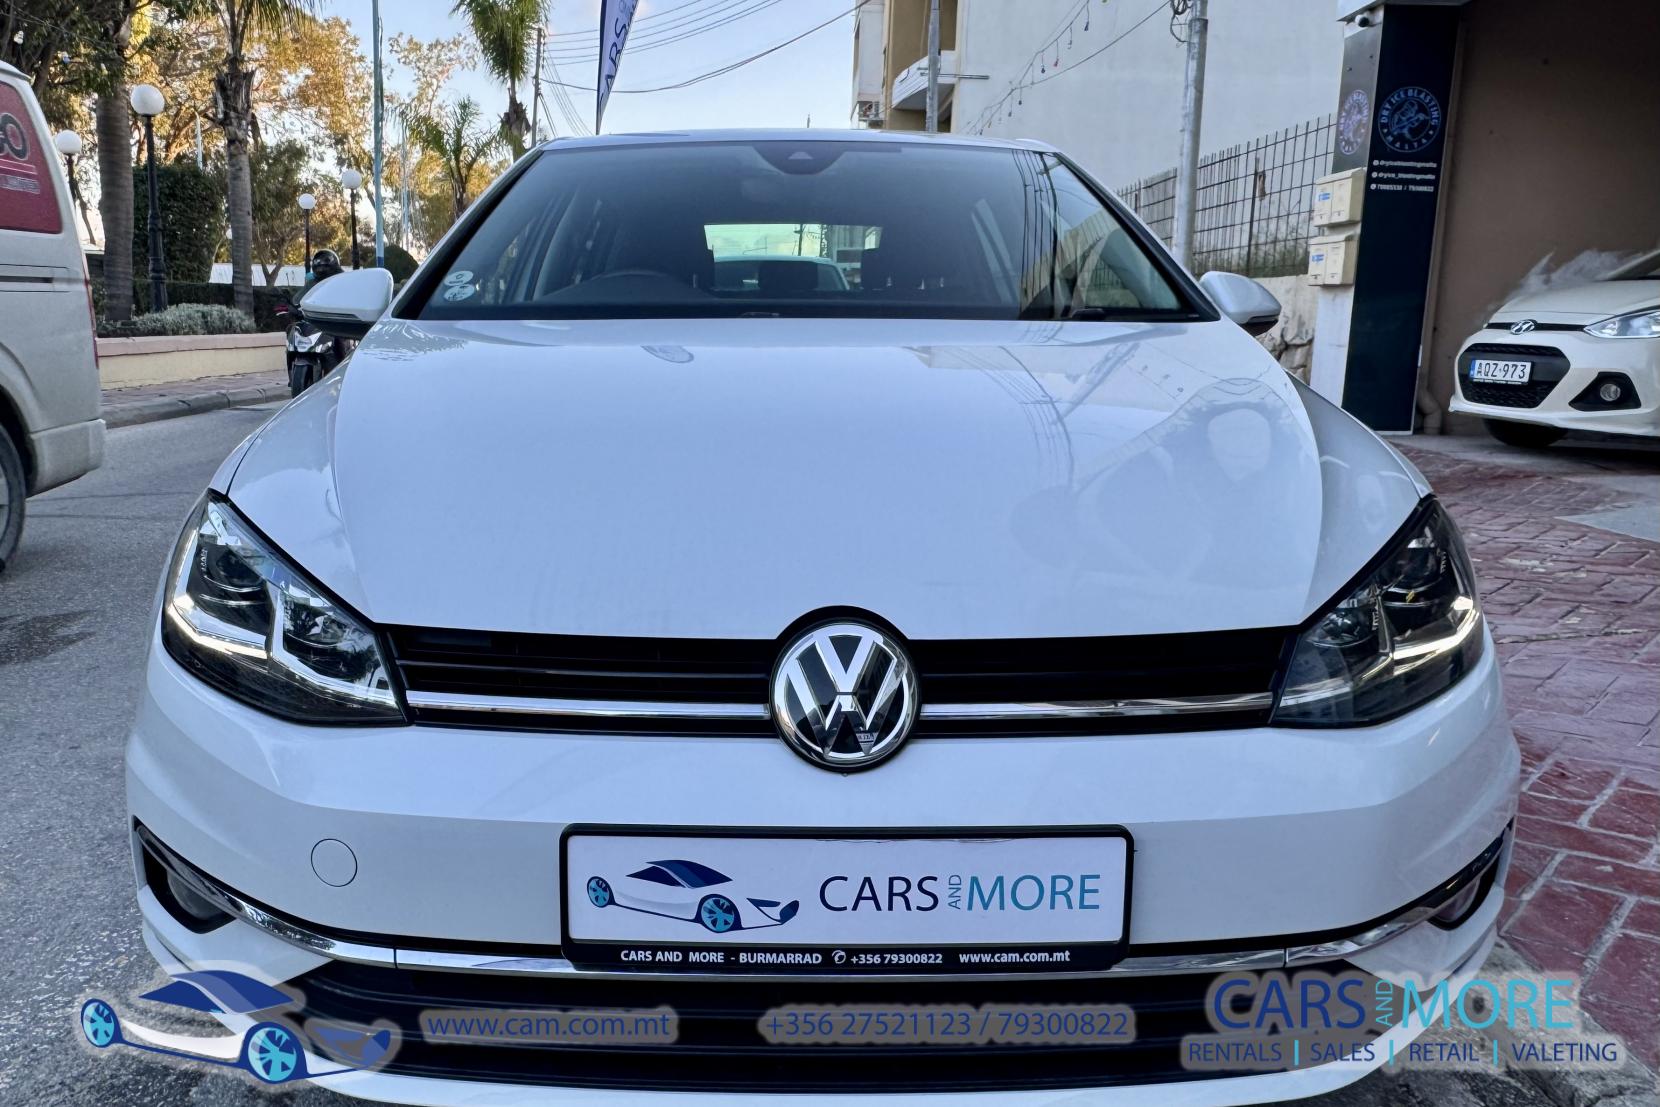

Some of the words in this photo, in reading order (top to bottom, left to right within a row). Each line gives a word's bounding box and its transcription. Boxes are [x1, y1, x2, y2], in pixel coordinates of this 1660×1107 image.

[819, 875, 939, 912] CARS
[947, 874, 962, 910] AND
[966, 874, 1101, 911] MORE
[620, 949, 652, 962] CARS
[655, 951, 683, 962] AND
[688, 951, 725, 963] MORE
[739, 952, 823, 965] BURMARRAD
[850, 953, 881, 965] +356
[883, 953, 943, 965] 79300822
[958, 950, 1071, 965] www.cam.com.mt
